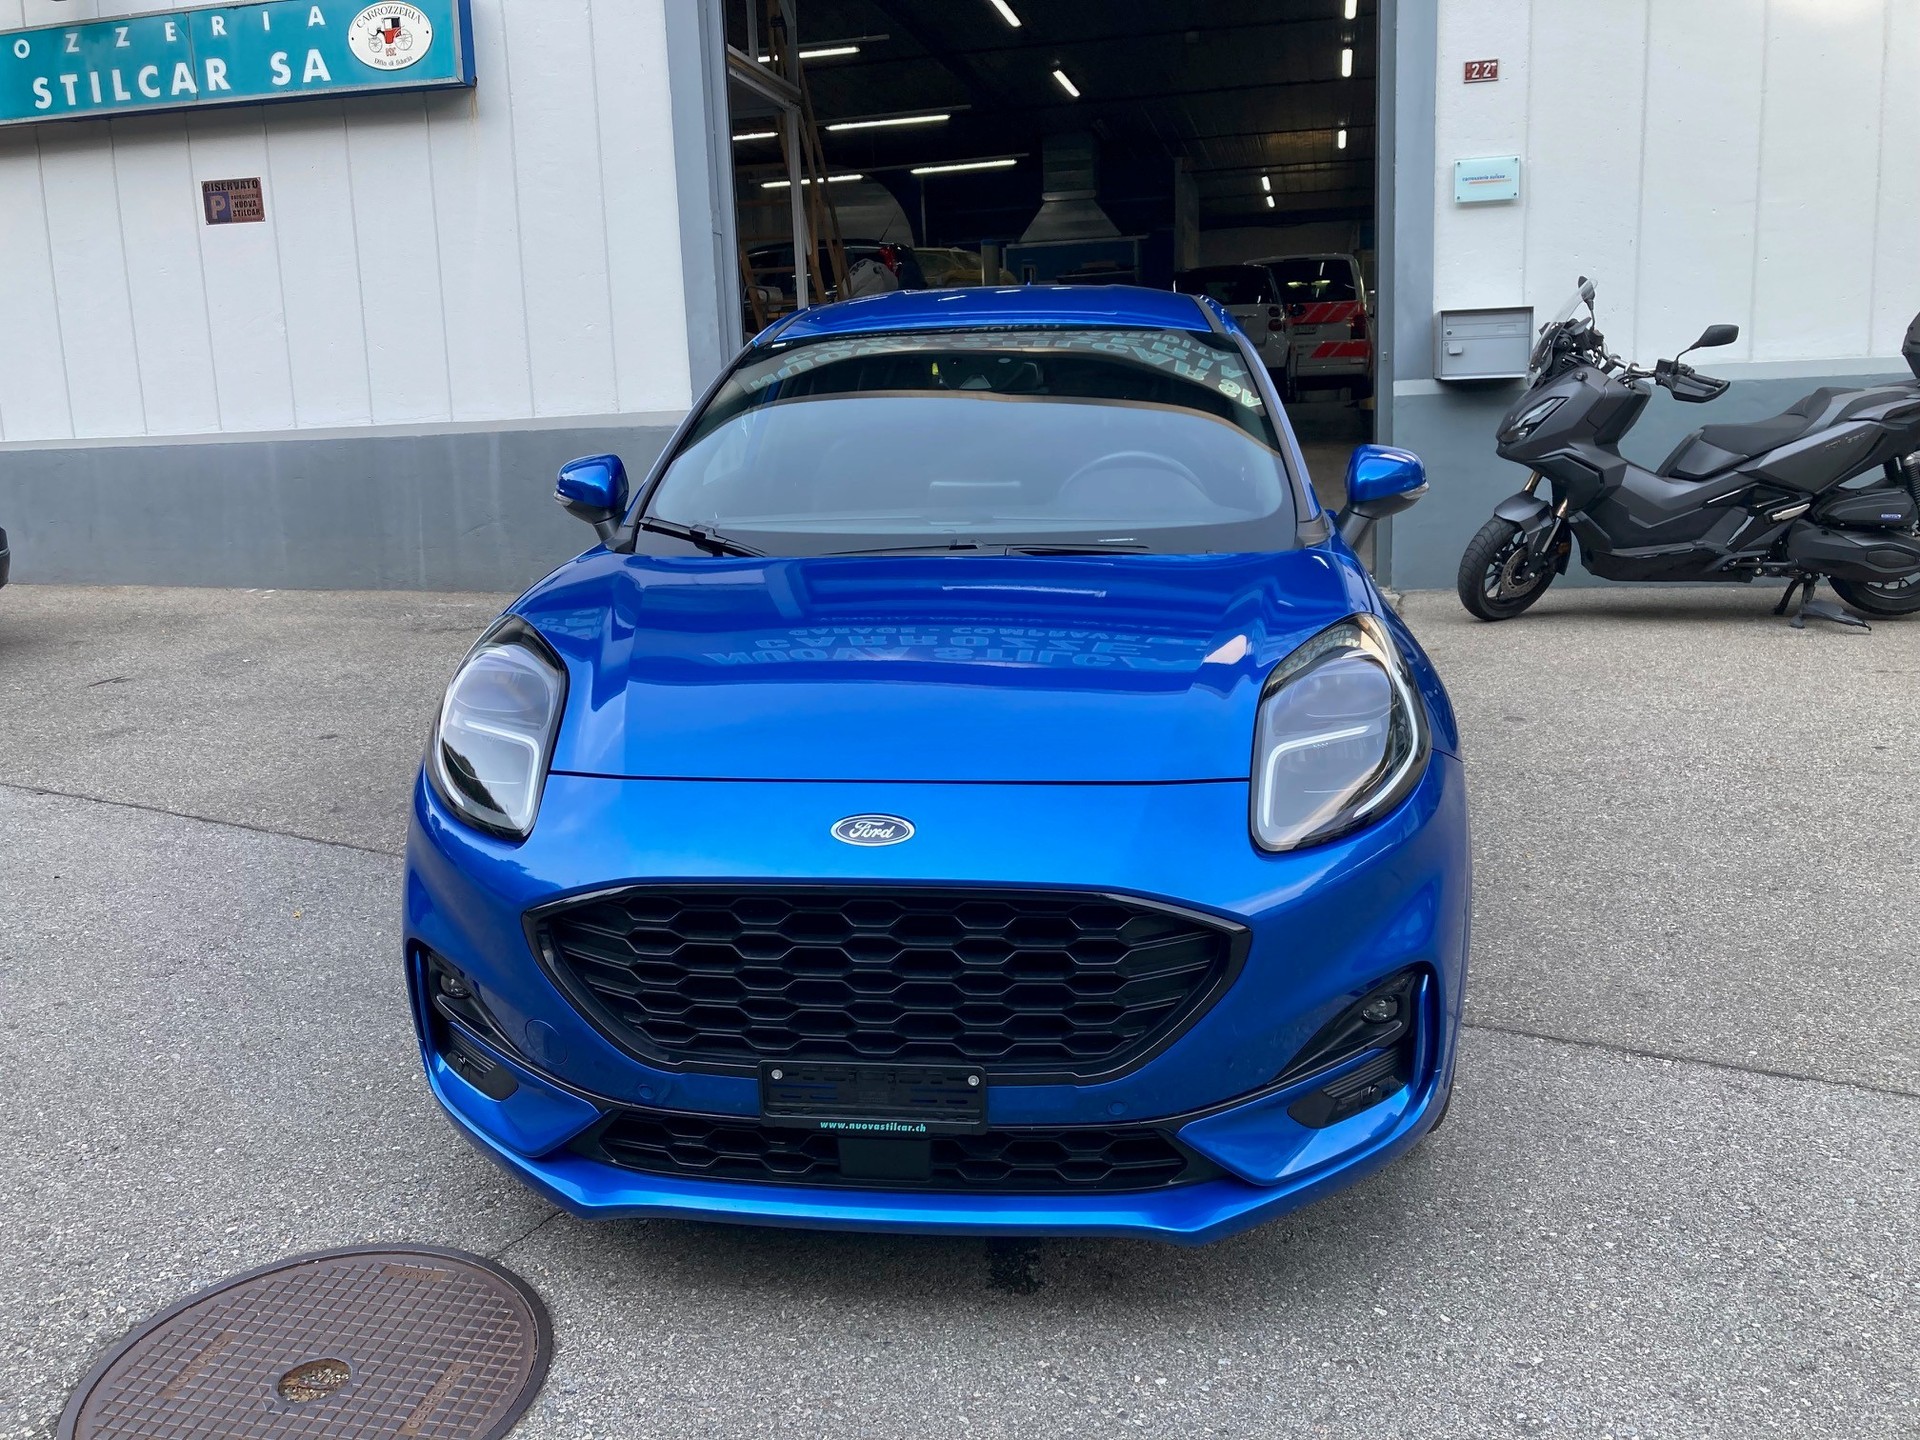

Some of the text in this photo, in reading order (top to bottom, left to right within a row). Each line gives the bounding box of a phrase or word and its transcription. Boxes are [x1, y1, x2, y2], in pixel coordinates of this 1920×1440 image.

[356, 6, 421, 28] CARROZZERIA
[33, 49, 332, 109] STILCAR SA
[204, 180, 258, 192] RISERVATO
[211, 195, 226, 219] P
[234, 200, 257, 208] NUOVA
[849, 820, 895, 839] Ford
[820, 1120, 926, 1133] www.nuovastilcar.ch
